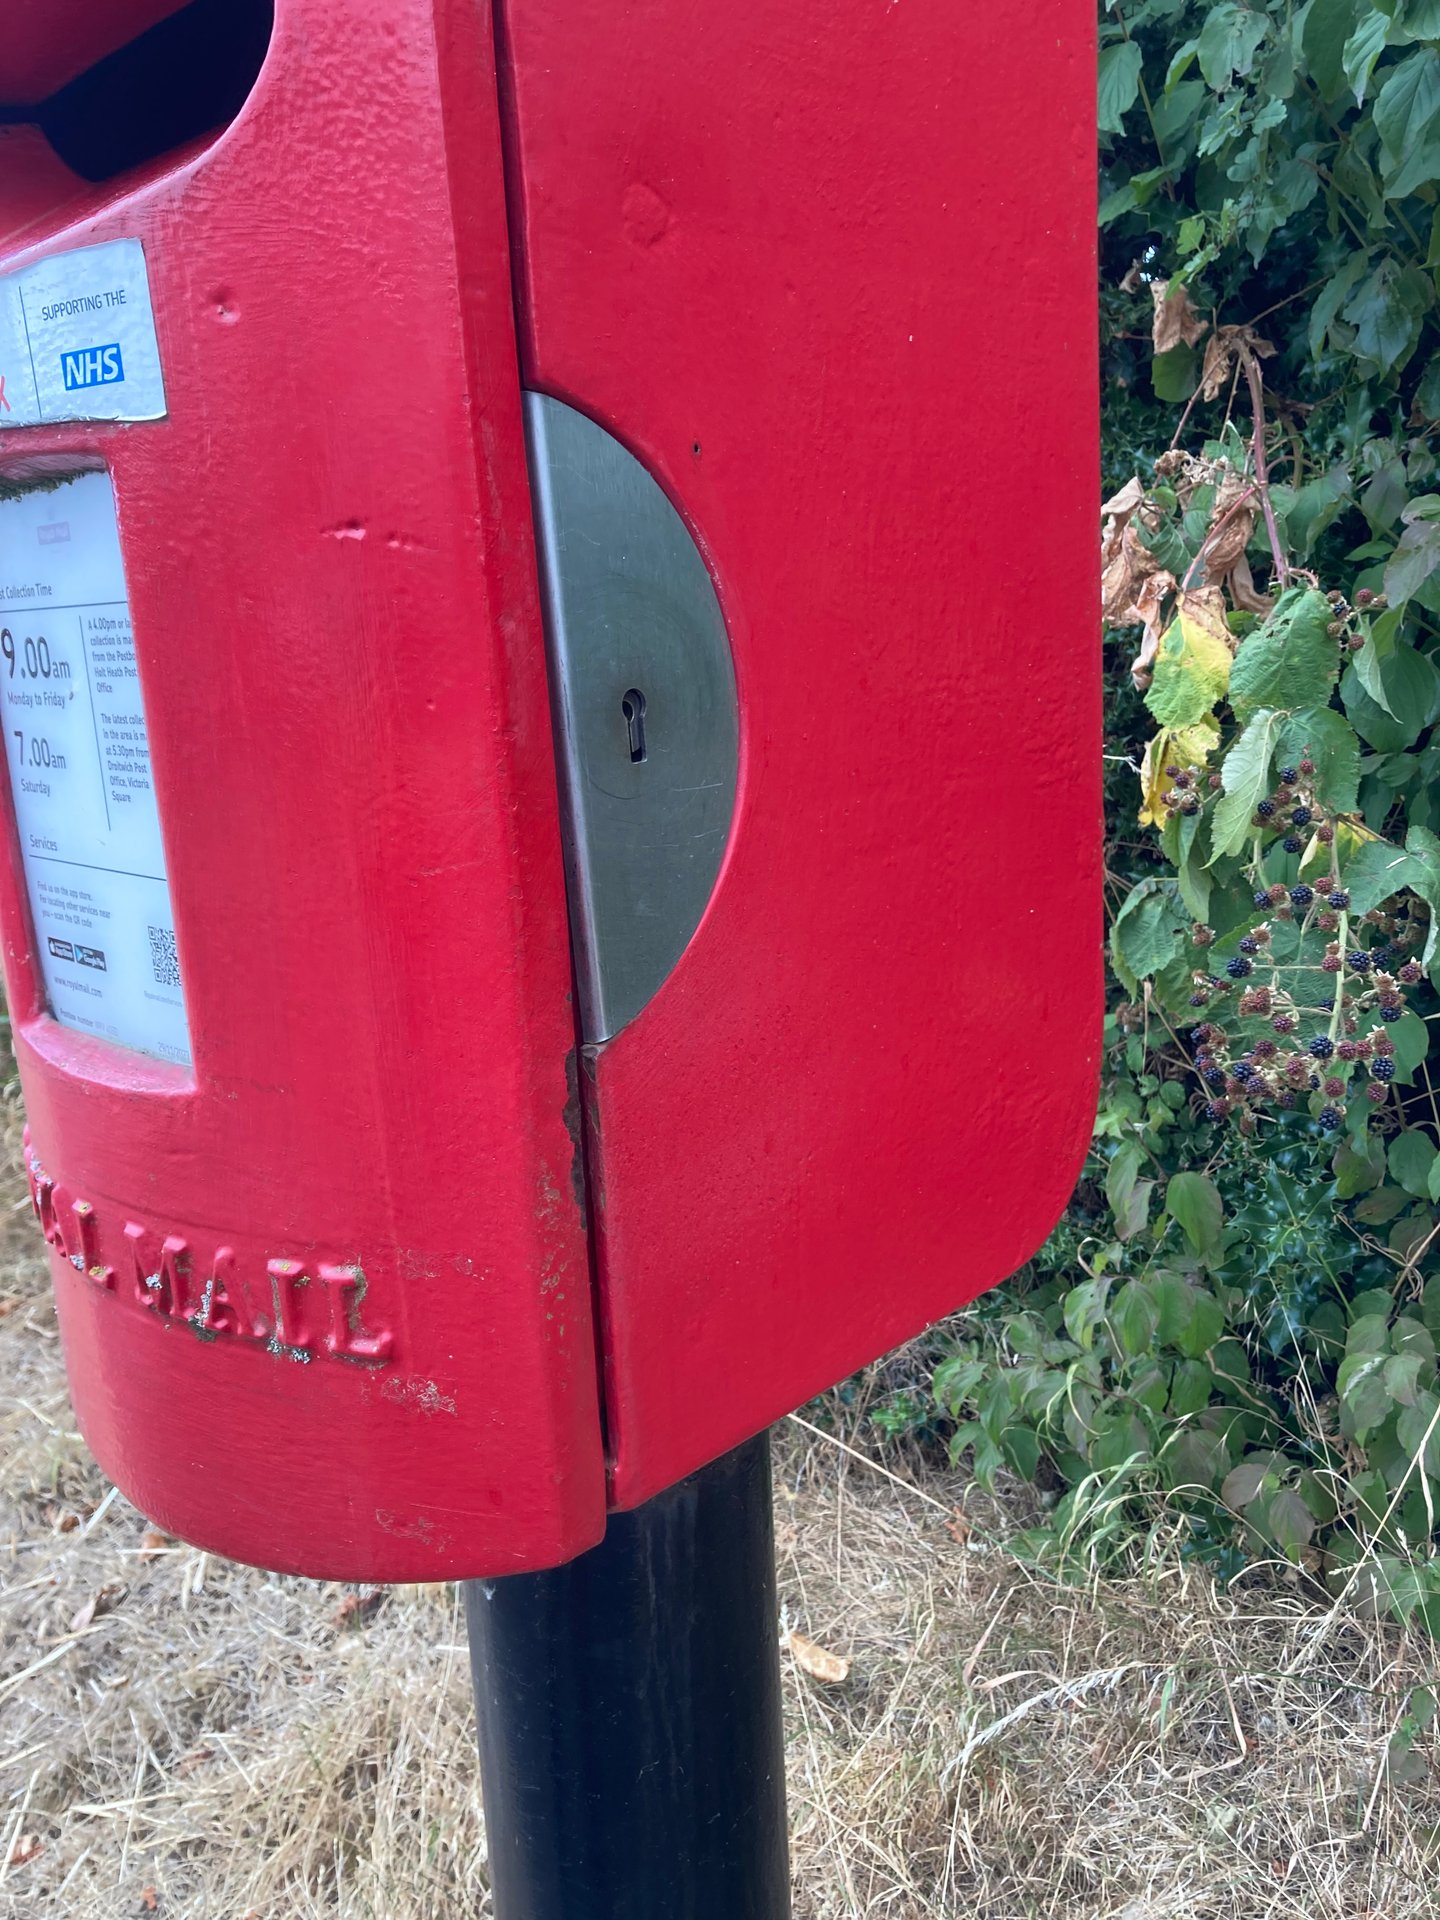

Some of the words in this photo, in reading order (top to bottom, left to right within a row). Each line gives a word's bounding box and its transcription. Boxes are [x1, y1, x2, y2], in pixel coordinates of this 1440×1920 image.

[42, 294, 103, 321] SUPPORTING
[103, 289, 127, 307] THE
[65, 346, 120, 388] NHS
[6, 584, 36, 599] Collection
[35, 582, 53, 597] Time
[117, 620, 124, 629] or
[90, 634, 116, 646] collection
[116, 634, 122, 645] is
[1, 627, 71, 679] 9.00am
[92, 651, 106, 662] from
[106, 651, 116, 662] the
[124, 666, 138, 678] Post
[96, 682, 113, 693] Office
[7, 690, 33, 709] Monday
[34, 691, 42, 705] to
[43, 691, 65, 710] Friday
[101, 713, 112, 724] The
[112, 714, 128, 725] latest
[102, 728, 109, 740] in
[109, 729, 119, 740] the
[120, 731, 132, 741] area
[132, 729, 139, 741] is
[14, 730, 67, 770] 7.00am
[106, 746, 112, 756] at
[112, 744, 135, 760] 5.30pm
[135, 747, 150, 758] from
[134, 762, 147, 774] Post
[21, 778, 51, 798] Saturday
[109, 775, 128, 788] Office,
[128, 777, 150, 790] Victoria
[112, 790, 131, 803] Square
[29, 834, 58, 852] Services
[123, 1221, 393, 1361] MAIL
